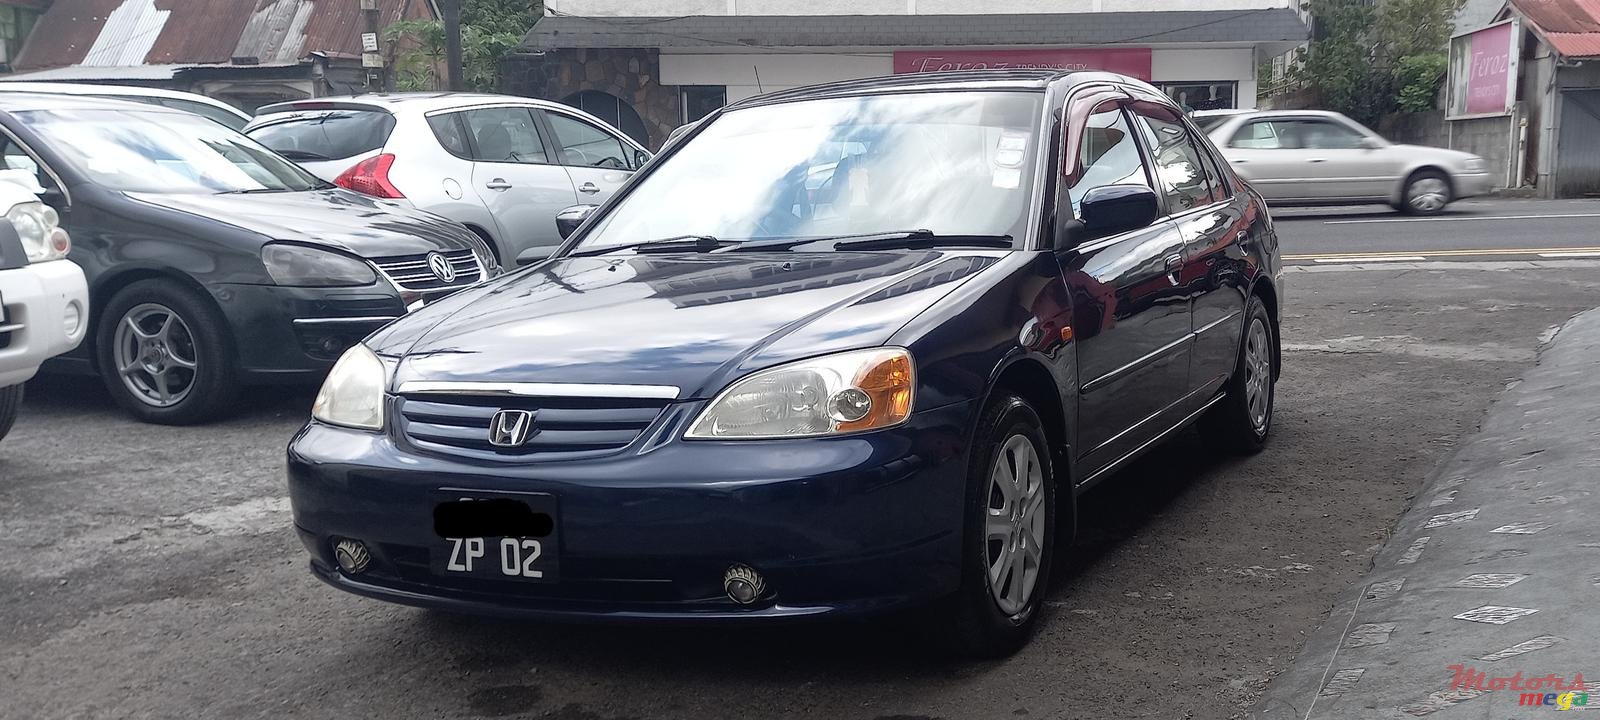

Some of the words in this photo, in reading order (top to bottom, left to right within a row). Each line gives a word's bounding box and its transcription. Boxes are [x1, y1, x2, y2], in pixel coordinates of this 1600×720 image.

[1471, 51, 1508, 81] Feroz
[446, 537, 484, 572] ZP
[501, 538, 543, 578] 02
